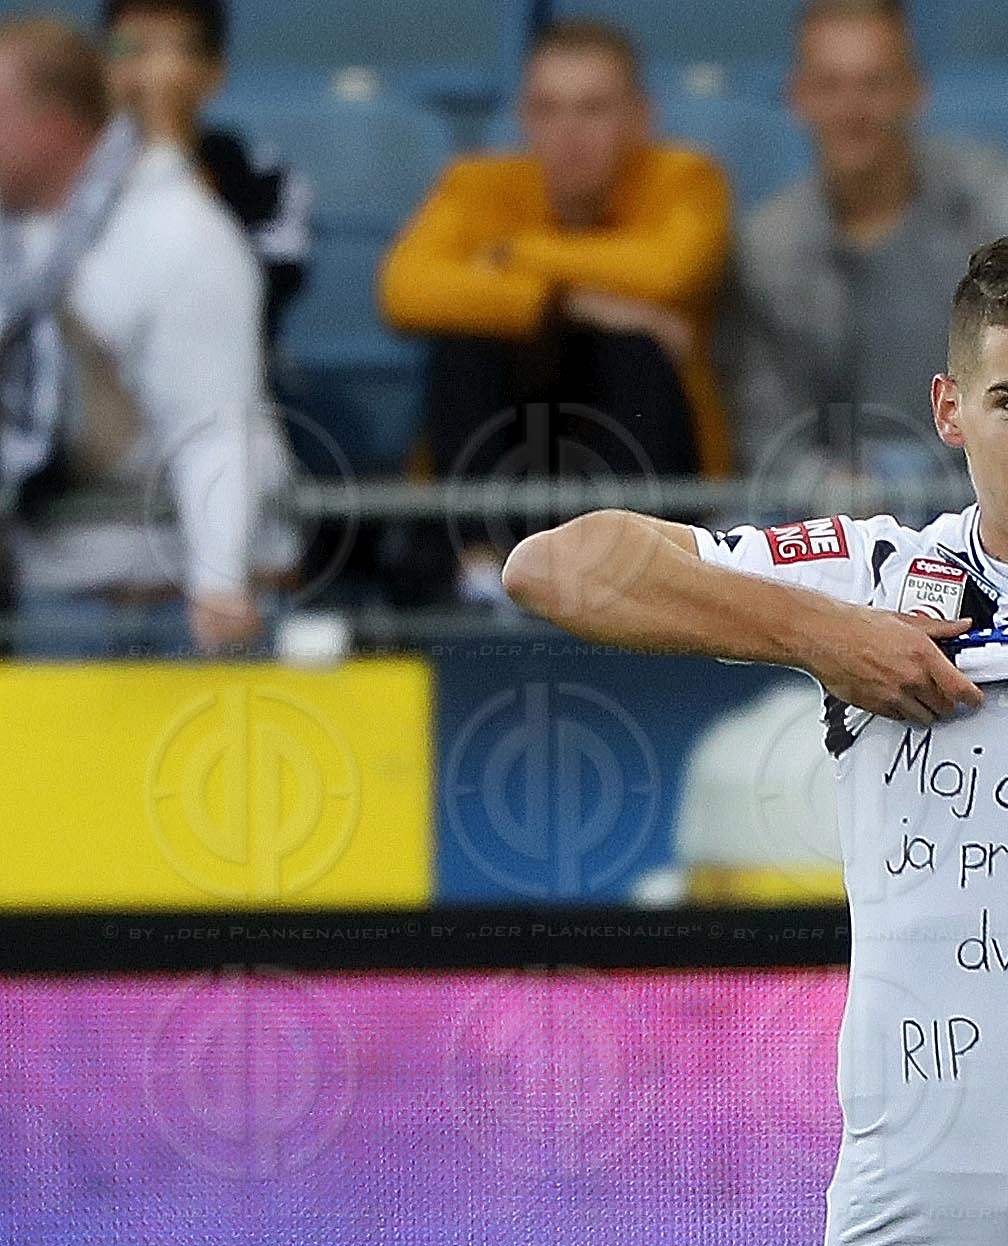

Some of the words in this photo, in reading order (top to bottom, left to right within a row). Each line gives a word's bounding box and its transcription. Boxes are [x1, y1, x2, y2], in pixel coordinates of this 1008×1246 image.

[770, 526, 807, 559] NG
[908, 578, 958, 596] BUNDES
[916, 590, 945, 604] LIGA
[885, 726, 980, 818] Moj
[885, 818, 935, 875] ja
[901, 1017, 980, 1083] RIP
